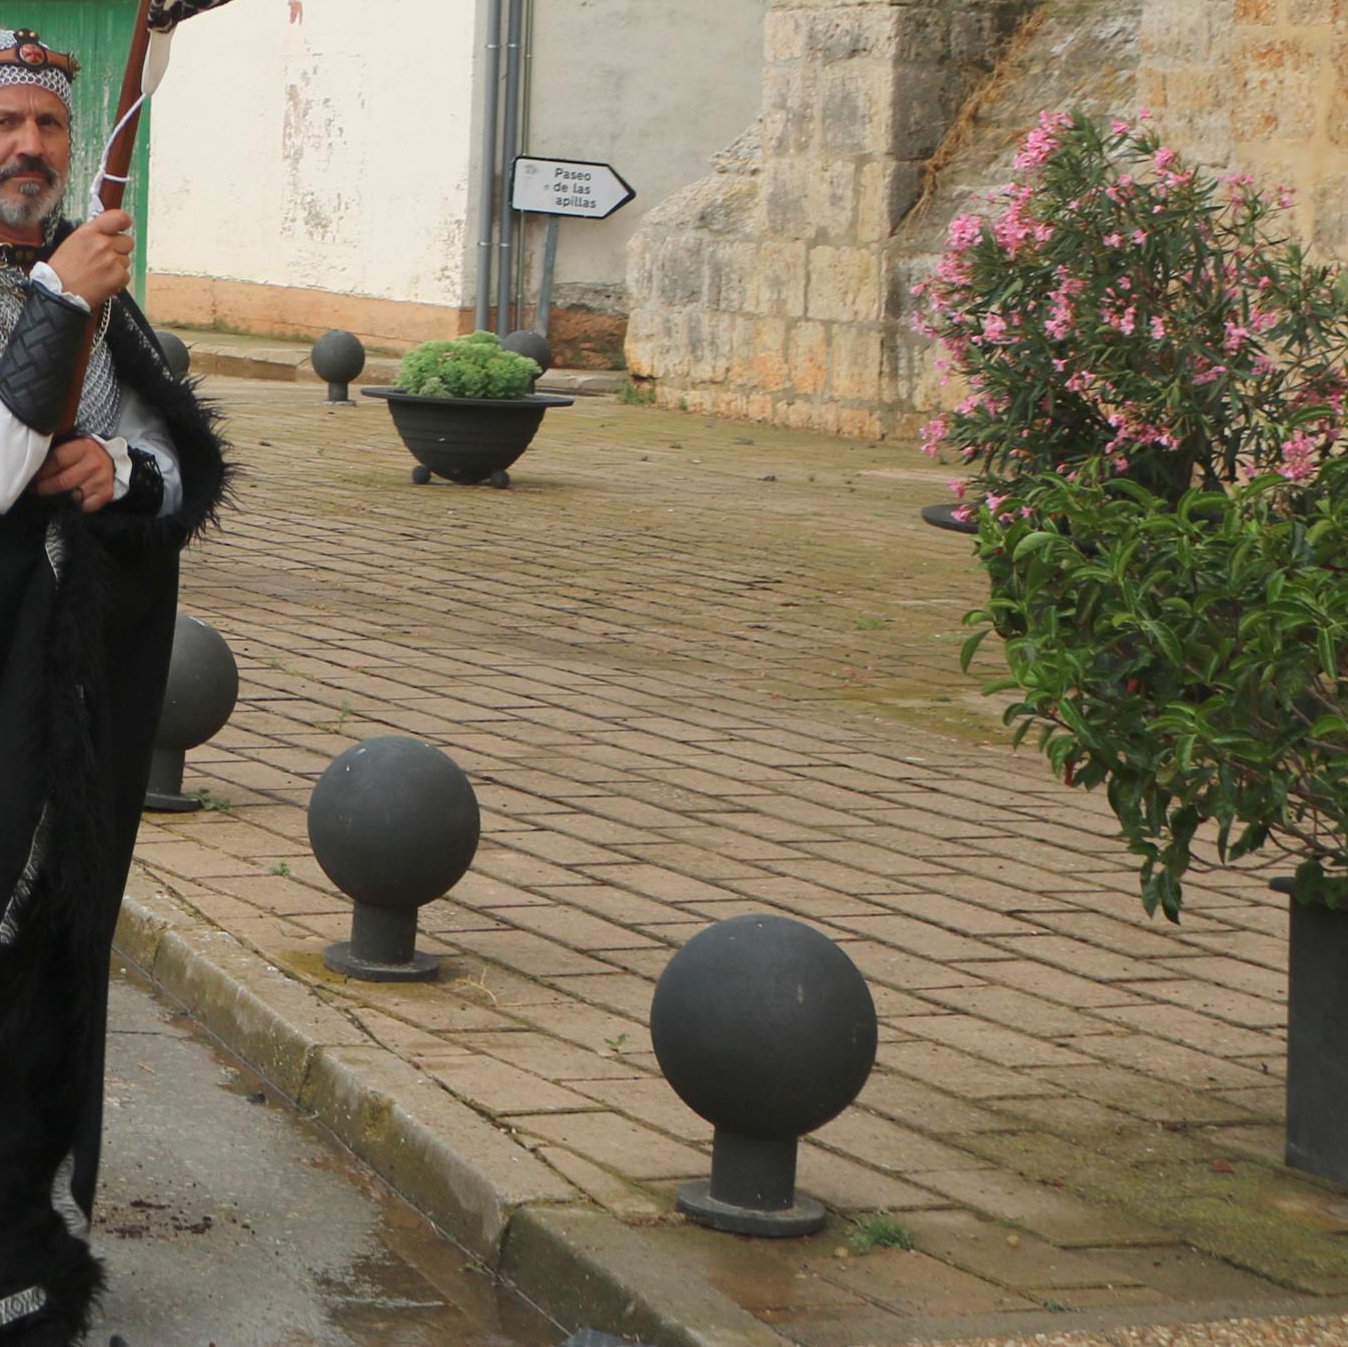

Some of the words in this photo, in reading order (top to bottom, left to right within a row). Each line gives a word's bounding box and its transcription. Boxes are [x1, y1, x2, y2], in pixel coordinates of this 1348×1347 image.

[554, 167, 592, 181] Paseo
[553, 182, 569, 193] de
[572, 183, 592, 195] las
[555, 196, 597, 209] apillas
